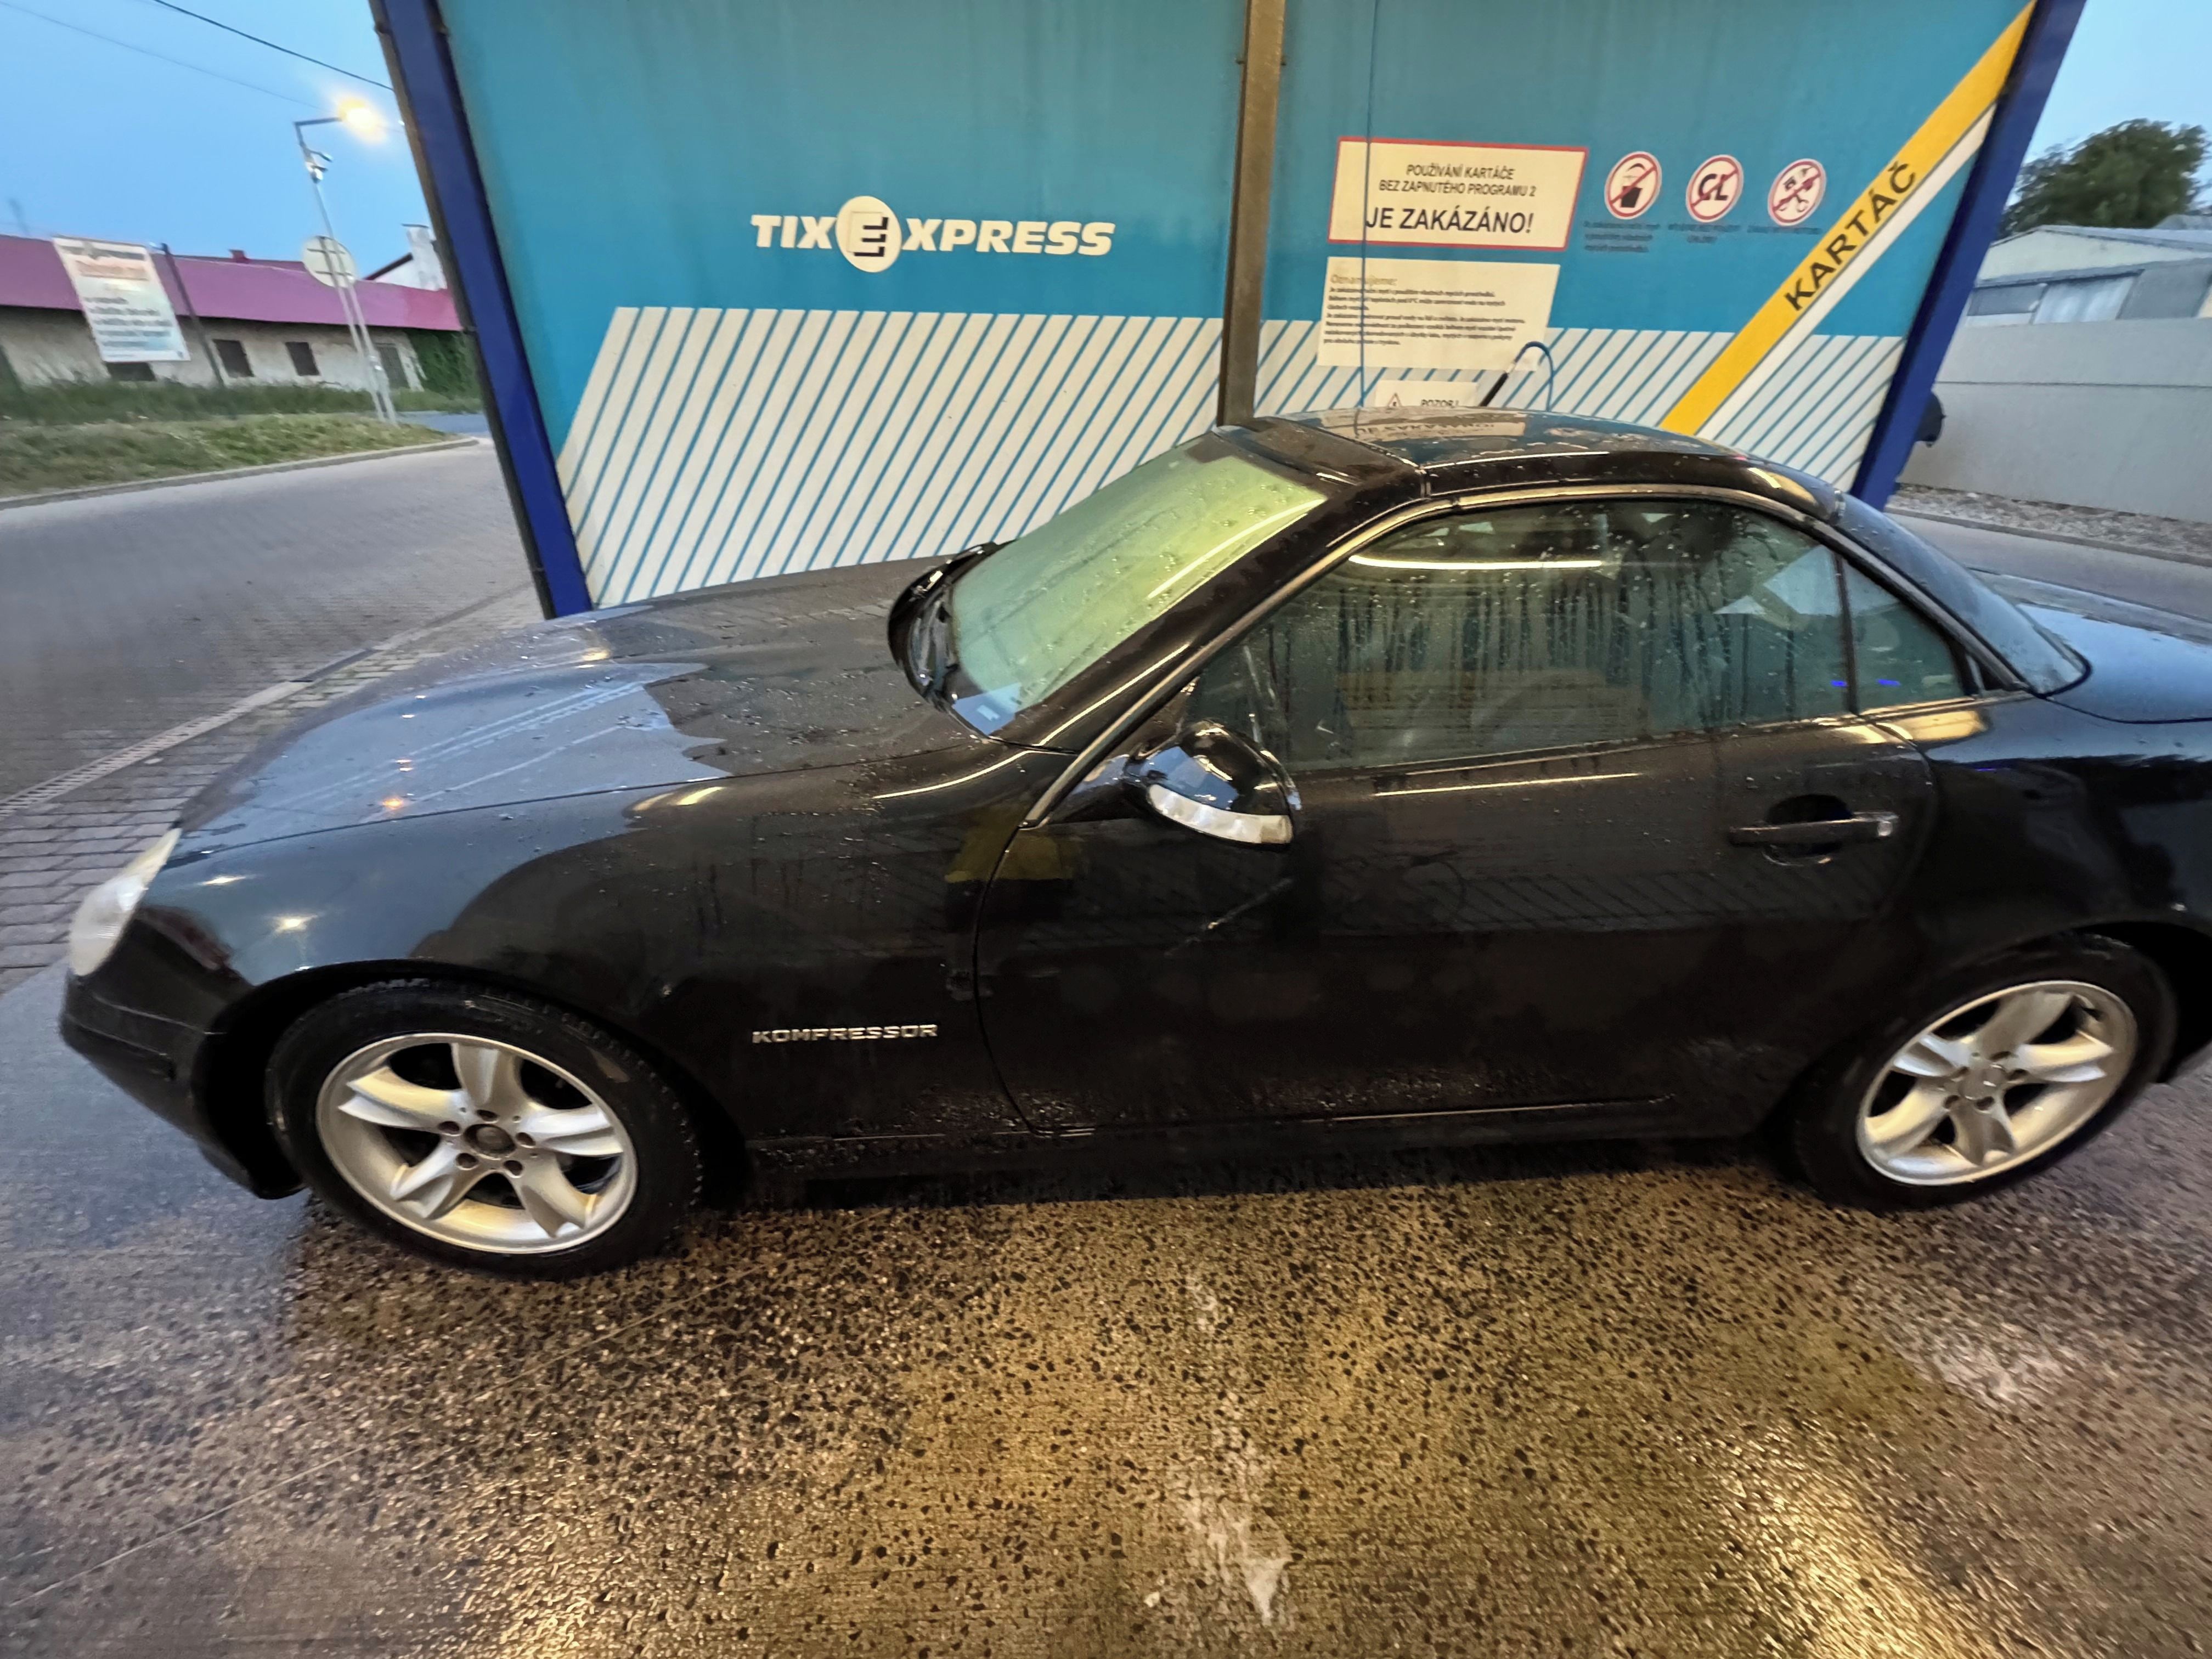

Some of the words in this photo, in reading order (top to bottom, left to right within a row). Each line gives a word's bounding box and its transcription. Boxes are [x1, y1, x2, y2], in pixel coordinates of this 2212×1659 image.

[1406, 162, 1463, 178] POUŽÍVÁNÍ
[1464, 165, 1515, 180] KARTÁČE
[1379, 179, 1400, 191] BEZ
[1401, 180, 1465, 194] ZAPNUTÉHO
[1467, 183, 1528, 196] PROGRAMU
[1529, 185, 1537, 197] 2
[1365, 207, 1395, 228] JE
[1399, 205, 1534, 234] ZAKÁZÁNO!
[1784, 161, 1915, 311] KARTÁČ
[752, 1024, 938, 1043] KOMPRESSOR
